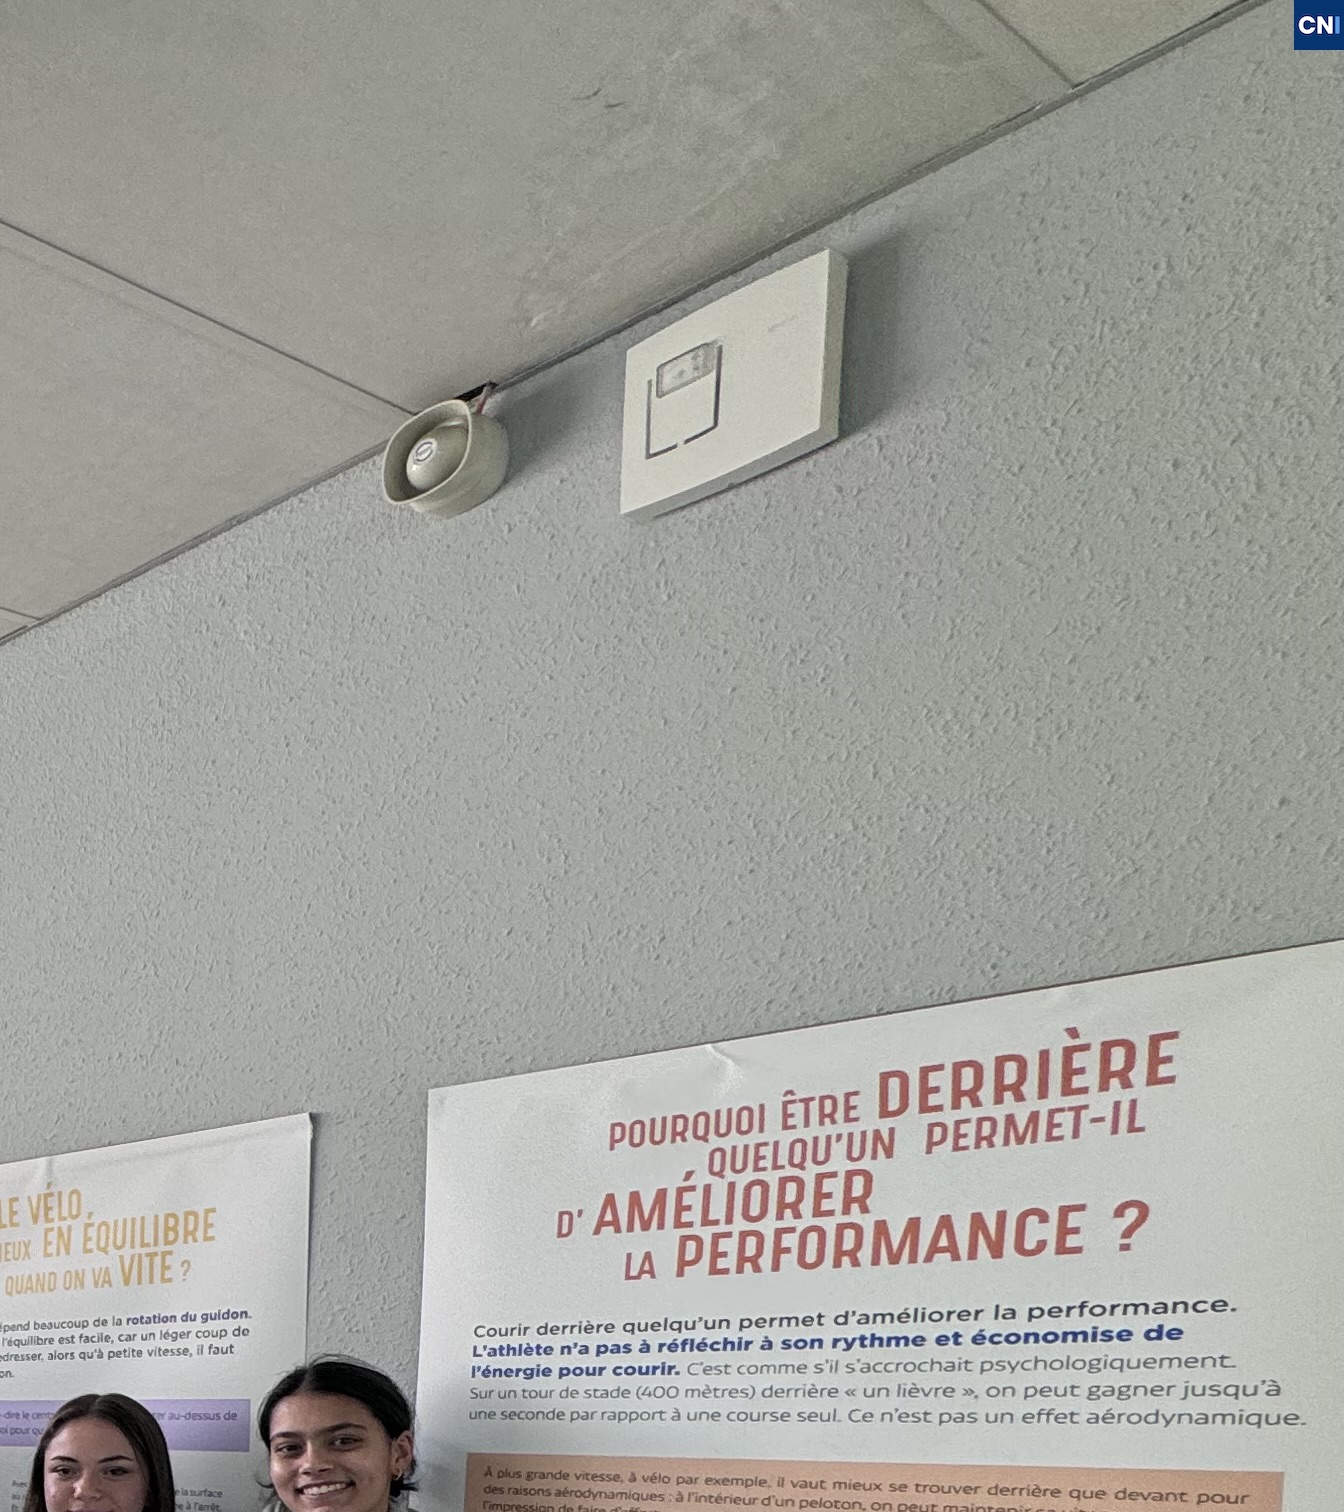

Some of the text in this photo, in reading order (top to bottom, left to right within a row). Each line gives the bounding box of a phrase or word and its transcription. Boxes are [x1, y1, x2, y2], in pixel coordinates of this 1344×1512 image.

[610, 1026, 1181, 1150] POURQUOI ÊTRE DERRIÈRE
[708, 1099, 1146, 1179] QUELQU'UN PERMET-IL
[27, 1182, 82, 1226] VÉLO
[593, 1169, 874, 1236] AMÉLIORER
[43, 1226, 72, 1258] EN
[82, 1208, 217, 1255] ÉQUILIBRE
[624, 1199, 1151, 1281] LA PERFORMANCE ?
[4, 1250, 192, 1296] QUAND ON VA VITE ?
[473, 1296, 1236, 1338] Courir derrière quelqu'un permet d'améliorer la performance.
[472, 1324, 1183, 1359] L'athlète n'a pas à réfléchir à son rythme et économise de
[558, 1365, 607, 1382] pour
[611, 1360, 680, 1377] courir.
[736, 1363, 808, 1375] comme
[979, 1352, 1236, 1377] psychologiquement.
[470, 1385, 494, 1400] Sur
[497, 1388, 517, 1399] un
[521, 1385, 555, 1399] tour
[558, 1384, 579, 1399] de
[583, 1384, 631, 1399] stade
[635, 1384, 679, 1403] (400
[684, 1383, 756, 1403] mètres)
[760, 1383, 839, 1398] derrière
[863, 1386, 890, 1398] un
[896, 1383, 956, 1399] lièvre
[985, 1386, 1016, 1398] on
[1023, 1381, 1080, 1403] peut
[1086, 1385, 1176, 1403] gagner
[468, 1410, 496, 1421] une
[500, 1406, 566, 1421] seconde
[569, 1410, 597, 1425] par
[600, 1406, 666, 1426] rapport
[670, 1407, 680, 1422] à
[686, 1410, 721, 1422] une
[726, 1410, 791, 1422] course
[796, 1407, 841, 1423] seul.
[847, 1407, 874, 1423] Ce
[938, 1412, 978, 1429] pas
[984, 1412, 1014, 1424] un
[1021, 1408, 1080, 1425] effet
[1085, 1408, 1306, 1431] aérodynamique.
